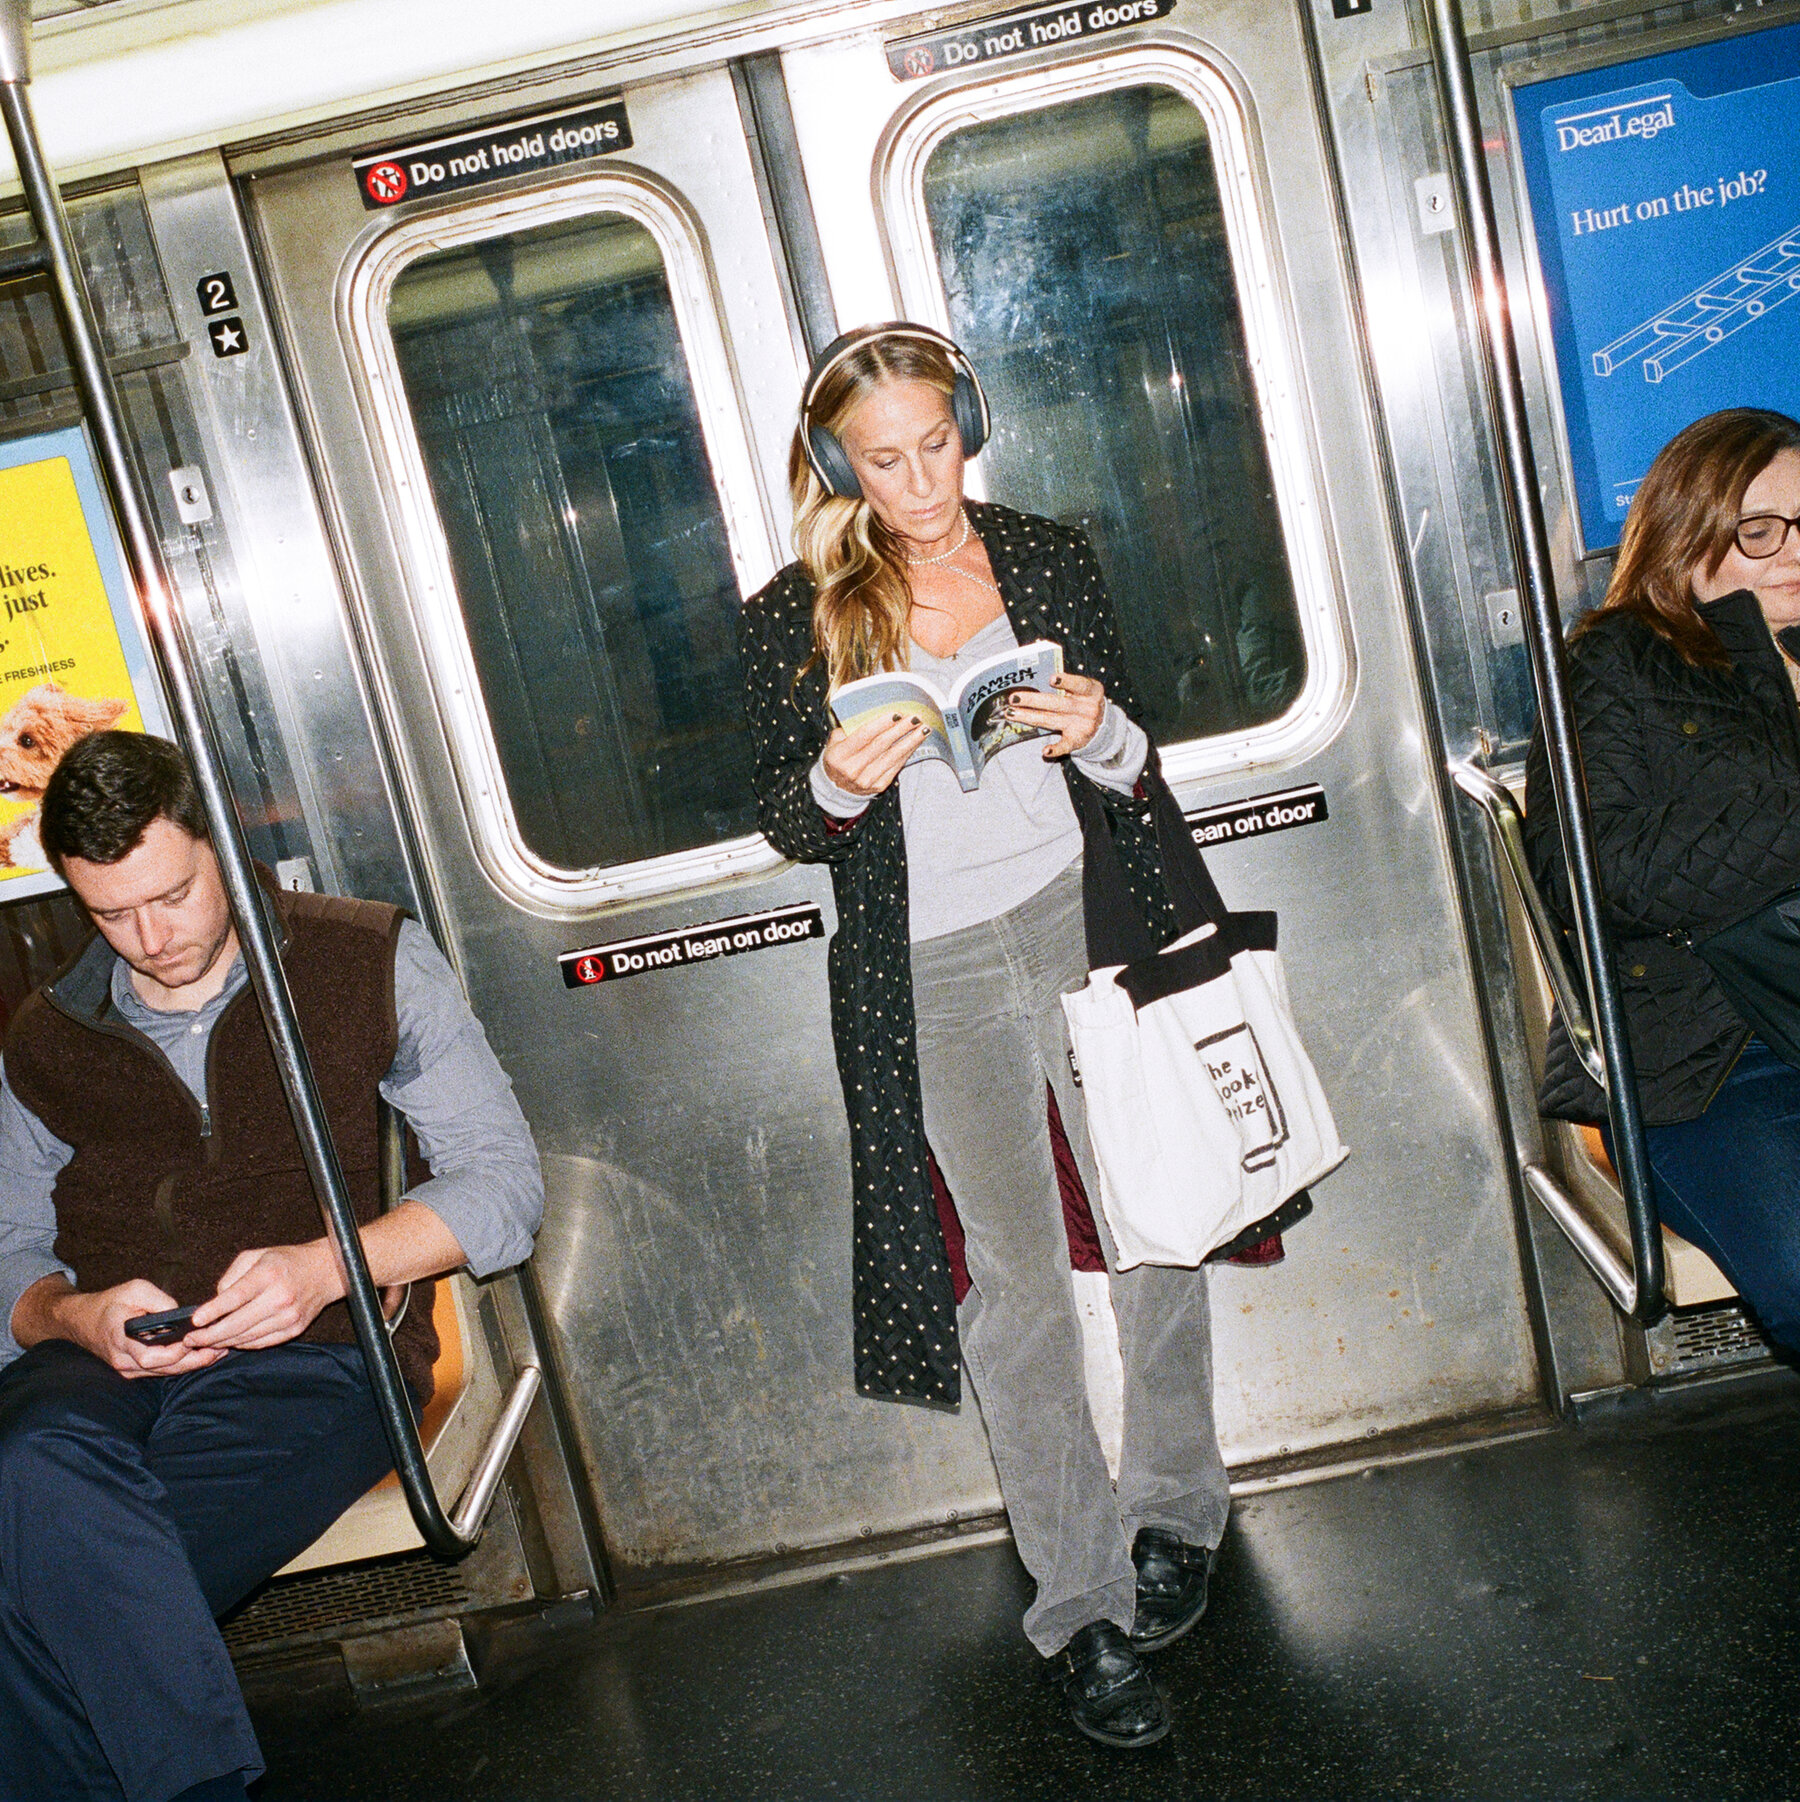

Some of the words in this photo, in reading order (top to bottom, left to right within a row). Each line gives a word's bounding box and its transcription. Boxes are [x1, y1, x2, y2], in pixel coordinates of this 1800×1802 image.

[944, 42, 979, 65] Do
[984, 30, 1025, 56] not
[1030, 12, 1082, 44] hold
[1088, 0, 1159, 29] doors
[1557, 103, 1676, 151] DearLegal
[410, 162, 446, 187] Do
[450, 150, 490, 177] not
[491, 133, 544, 167] hold
[549, 119, 619, 152] doors
[1571, 203, 1633, 236] Hurt
[1636, 197, 1670, 220] on
[1673, 184, 1715, 211] the
[1715, 168, 1767, 208] job?
[207, 280, 230, 309] 2
[0, 562, 57, 589] lives.
[4, 589, 49, 623] just
[4, 658, 77, 683] FRESHNESS
[968, 666, 1032, 703] DAMON
[1190, 820, 1233, 844] ean
[1234, 814, 1264, 834] on
[1265, 801, 1316, 828] door
[611, 953, 644, 974] Do
[646, 944, 683, 967] not
[684, 933, 732, 960] lean
[733, 929, 761, 949] on
[763, 918, 813, 942] door
[1203, 1061, 1232, 1081] he
[1217, 1068, 1257, 1099] ook
